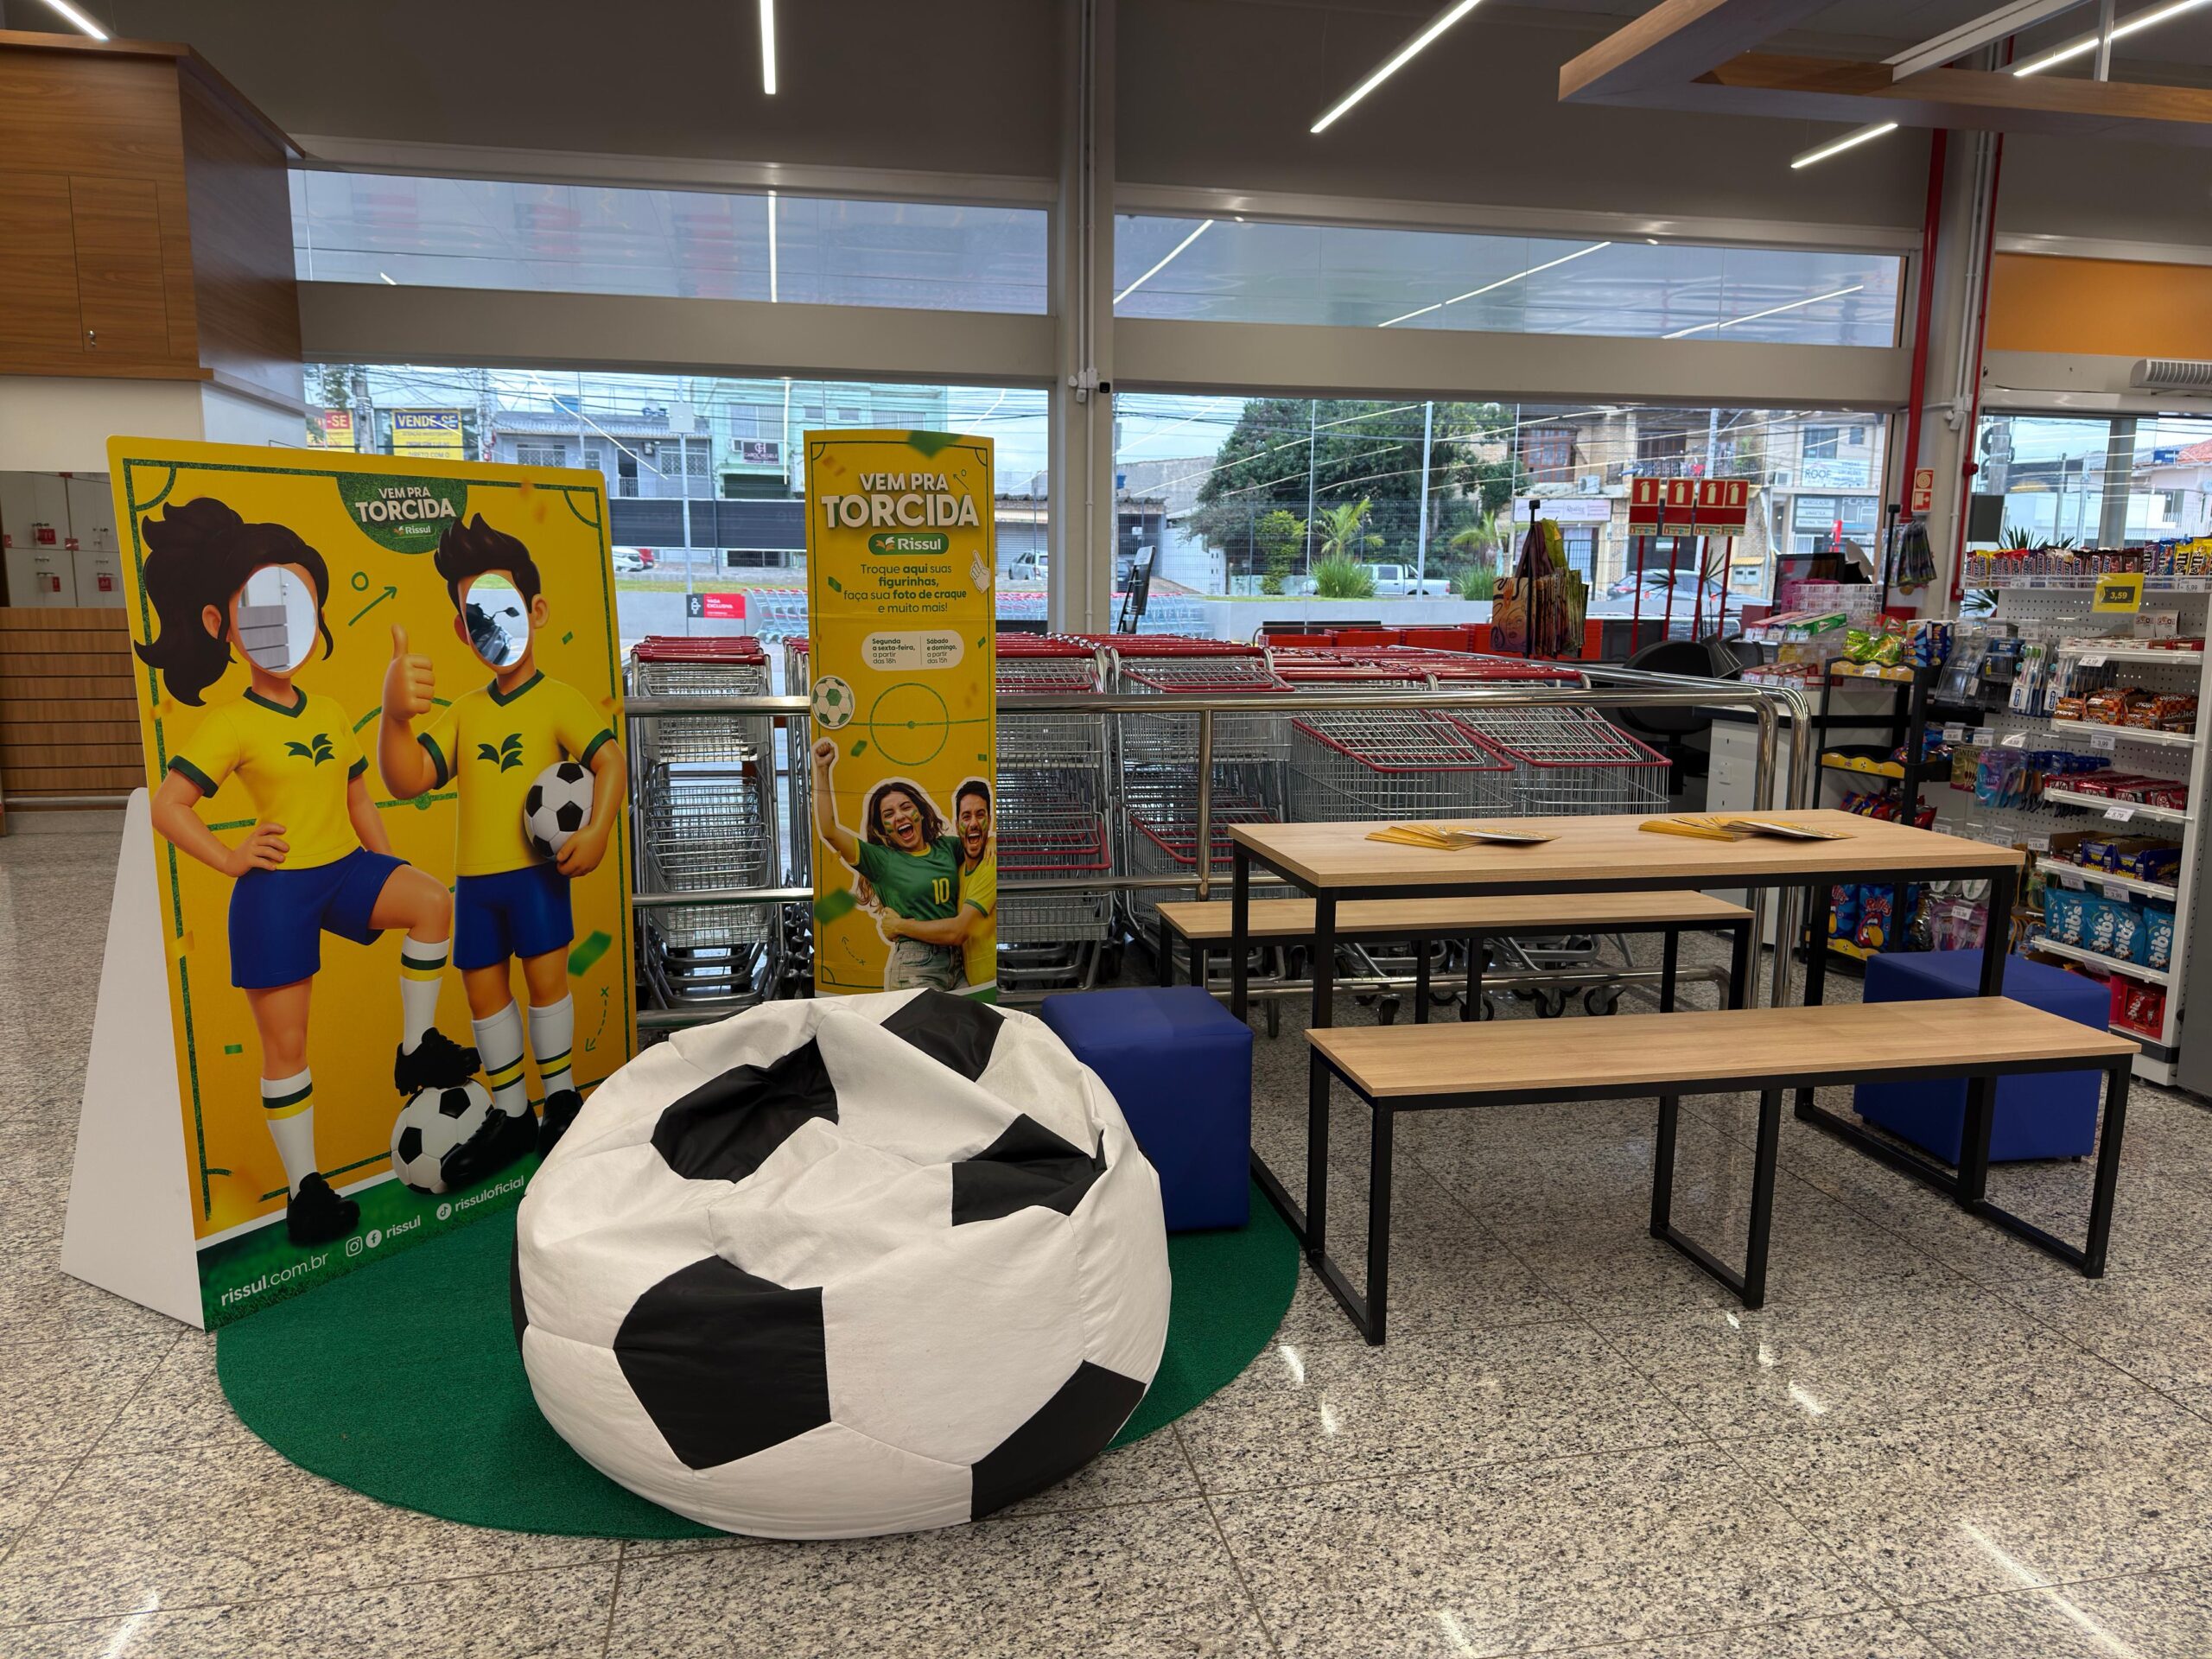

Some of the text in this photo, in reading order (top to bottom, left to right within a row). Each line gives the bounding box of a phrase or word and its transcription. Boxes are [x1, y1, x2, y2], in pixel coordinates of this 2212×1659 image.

[397, 415, 458, 428] VENDE-SE
[860, 474, 949, 492] VEM PRA
[378, 486, 431, 499] VEM PRA
[355, 498, 457, 523] TORCIDA
[821, 493, 980, 529] TORCIDA
[405, 525, 431, 535] Rissul
[898, 537, 941, 550] Rissul
[861, 563, 952, 575] Troque aqui suas
[879, 576, 939, 588] figurinhas,
[843, 589, 868, 602] faça
[893, 589, 917, 599] foto
[918, 589, 932, 599] de
[934, 590, 967, 601] craque
[2110, 591, 2127, 601] 3,59
[887, 603, 919, 613] muito
[922, 602, 948, 613] mais!
[932, 877, 950, 905] 10
[454, 1175, 525, 1212] rissuloficial
[385, 1215, 422, 1239] rissul
[220, 1250, 329, 1306] rissul.com.br
